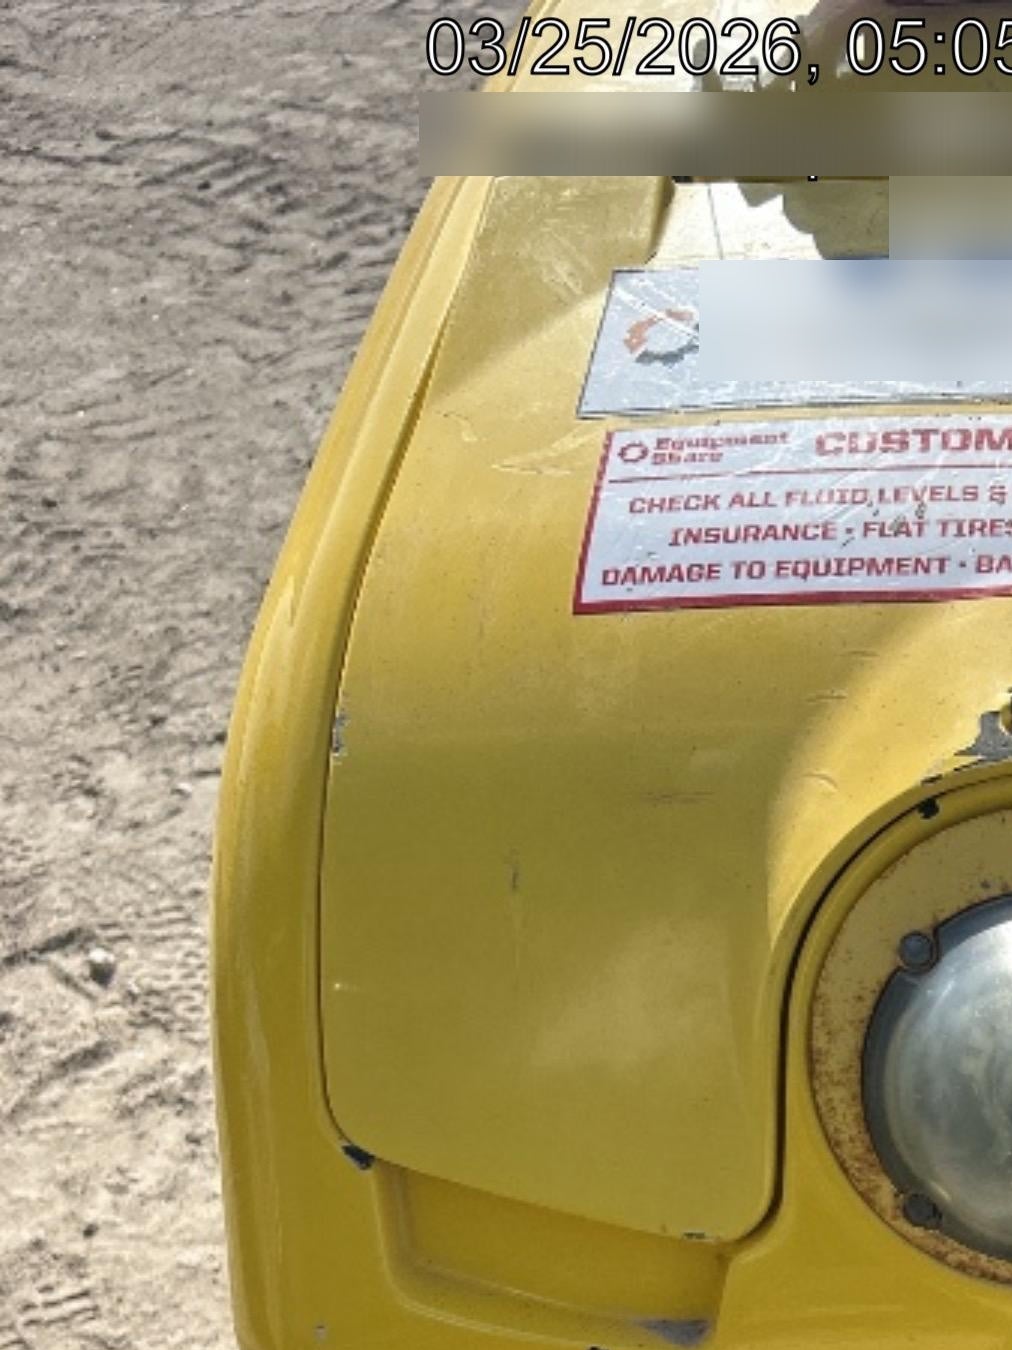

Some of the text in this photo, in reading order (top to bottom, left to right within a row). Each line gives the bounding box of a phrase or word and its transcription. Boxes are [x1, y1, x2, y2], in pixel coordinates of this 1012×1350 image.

[654, 432, 792, 451] Equipment
[651, 450, 723, 465] Share
[628, 495, 720, 514] CHECK
[729, 491, 778, 508] ALL
[784, 487, 867, 506] FLUID
[878, 484, 978, 504] LEVELS
[667, 522, 838, 547] INSURANCE
[862, 520, 928, 539] FLAT
[601, 563, 721, 586] DAMAGE
[733, 561, 765, 580] TO
[775, 557, 951, 580] EQUIPMENT
